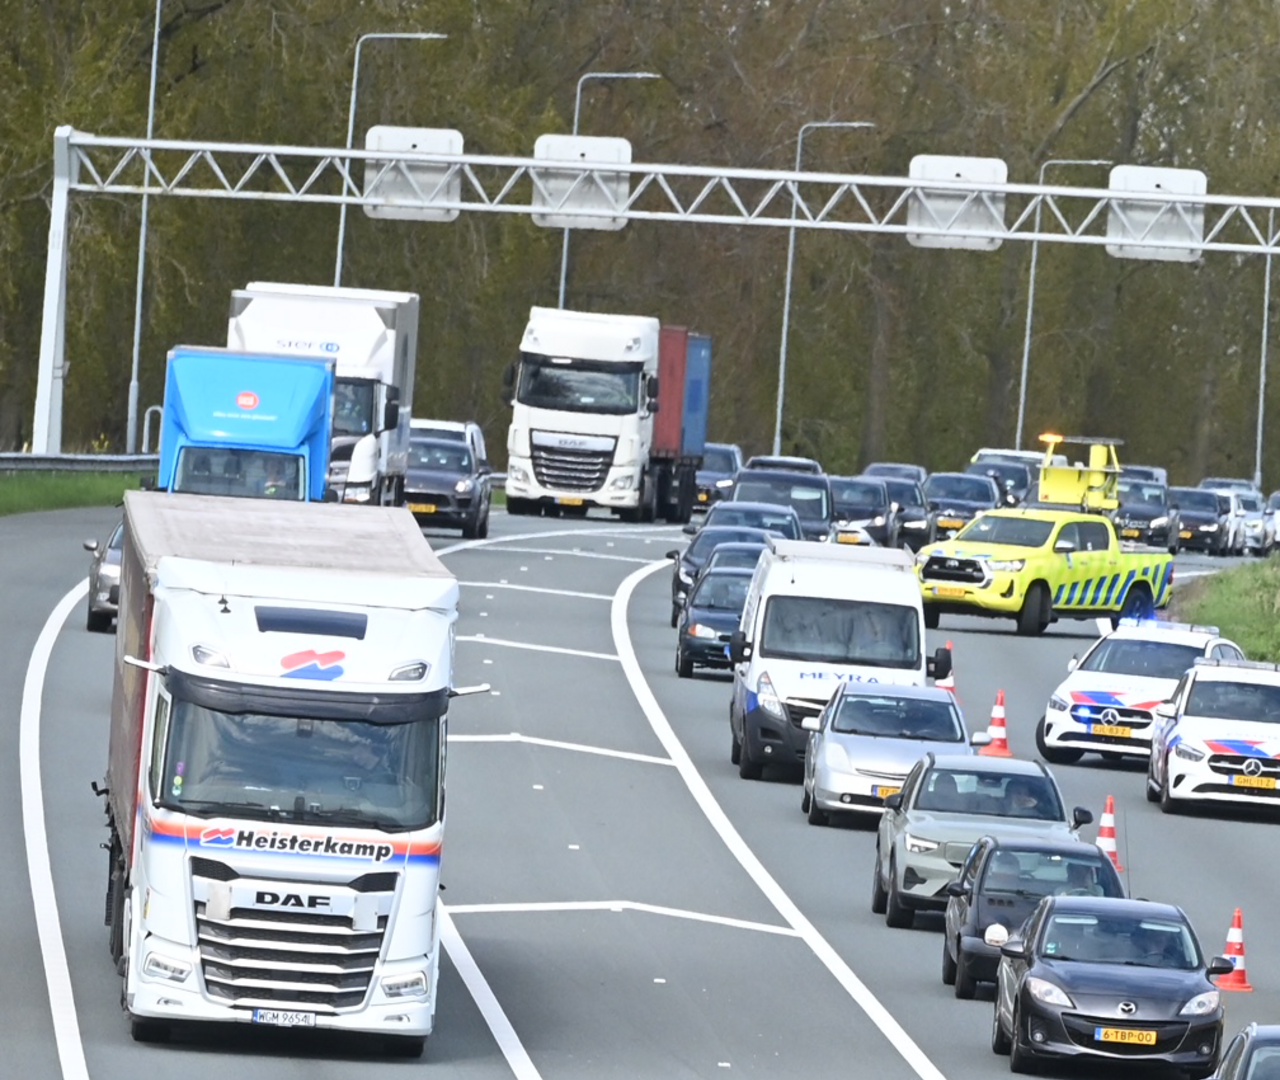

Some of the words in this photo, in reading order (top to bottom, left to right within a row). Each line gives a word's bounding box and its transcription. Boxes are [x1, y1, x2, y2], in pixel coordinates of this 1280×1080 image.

[236, 831, 393, 862] Heisterkamp
[255, 891, 331, 908] DAF
[1103, 1031, 1153, 1042] 6-TBP-00
